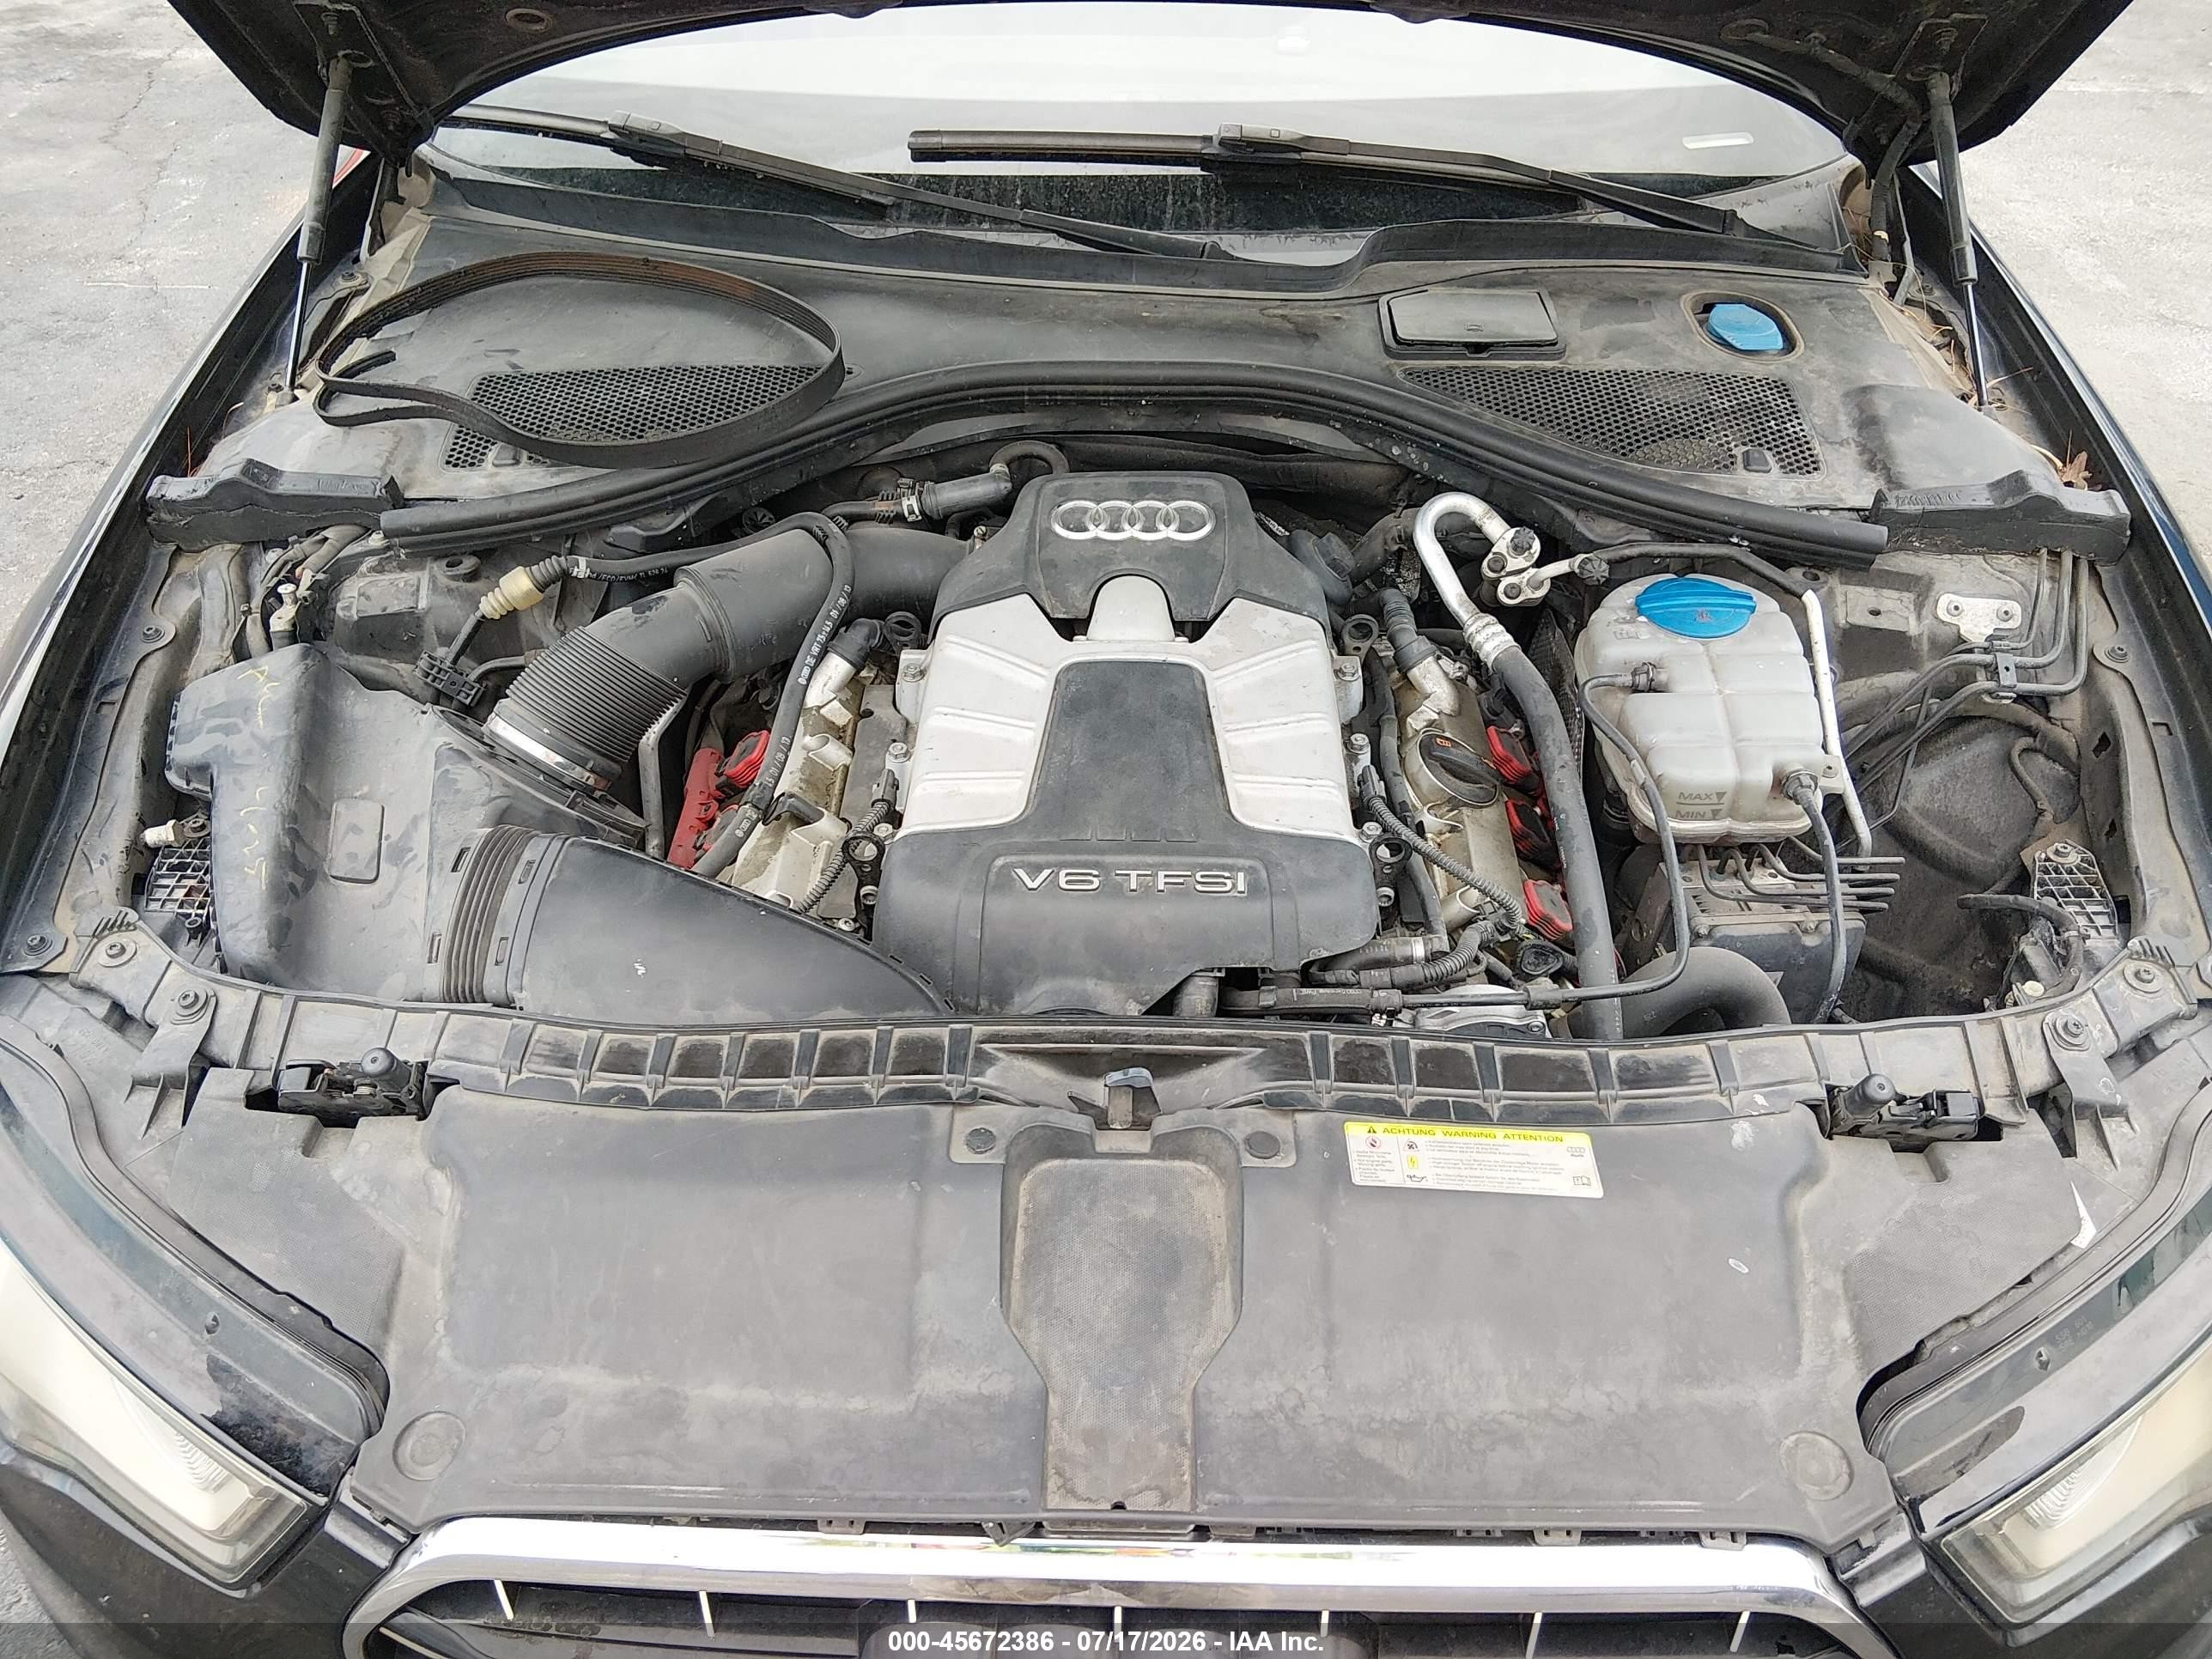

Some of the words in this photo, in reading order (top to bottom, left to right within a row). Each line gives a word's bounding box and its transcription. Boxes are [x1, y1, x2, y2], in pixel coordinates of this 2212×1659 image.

[1678, 791, 1714, 800] MAX
[1674, 810, 1706, 818] MIN
[1012, 868, 1101, 892] V6
[1114, 870, 1247, 895] TFSI
[1382, 1127, 1436, 1136] ACHTUNG
[1442, 1130, 1497, 1139] WARNING
[1503, 1133, 1564, 1143] ATTENTION
